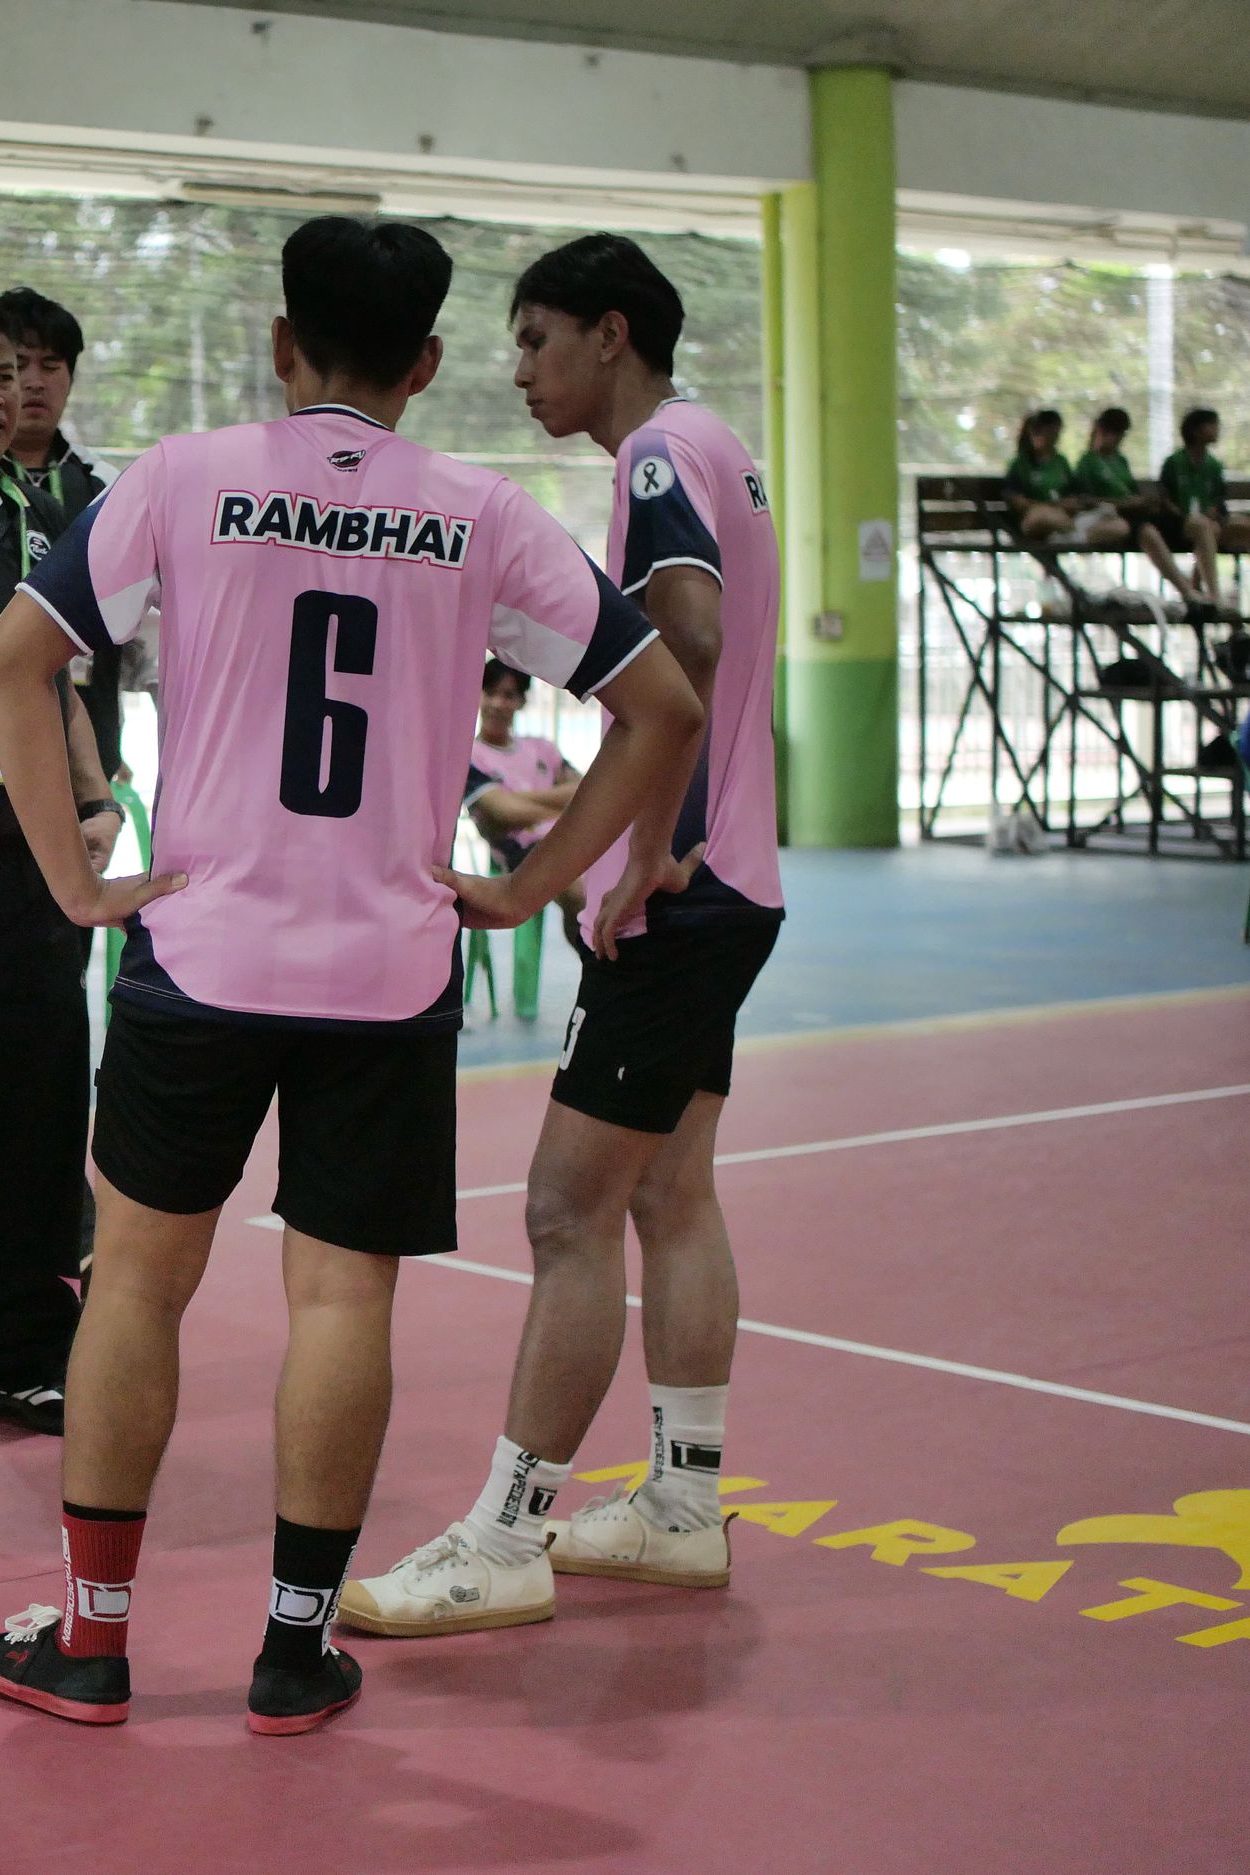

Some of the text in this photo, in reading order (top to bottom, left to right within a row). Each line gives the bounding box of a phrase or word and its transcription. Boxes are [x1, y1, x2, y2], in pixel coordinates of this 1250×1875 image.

[214, 493, 472, 566] RAMBHAI
[279, 590, 378, 818] 6
[61, 1560, 76, 1648] TAPEDESIGN
[572, 1459, 1250, 1648] ARAT
